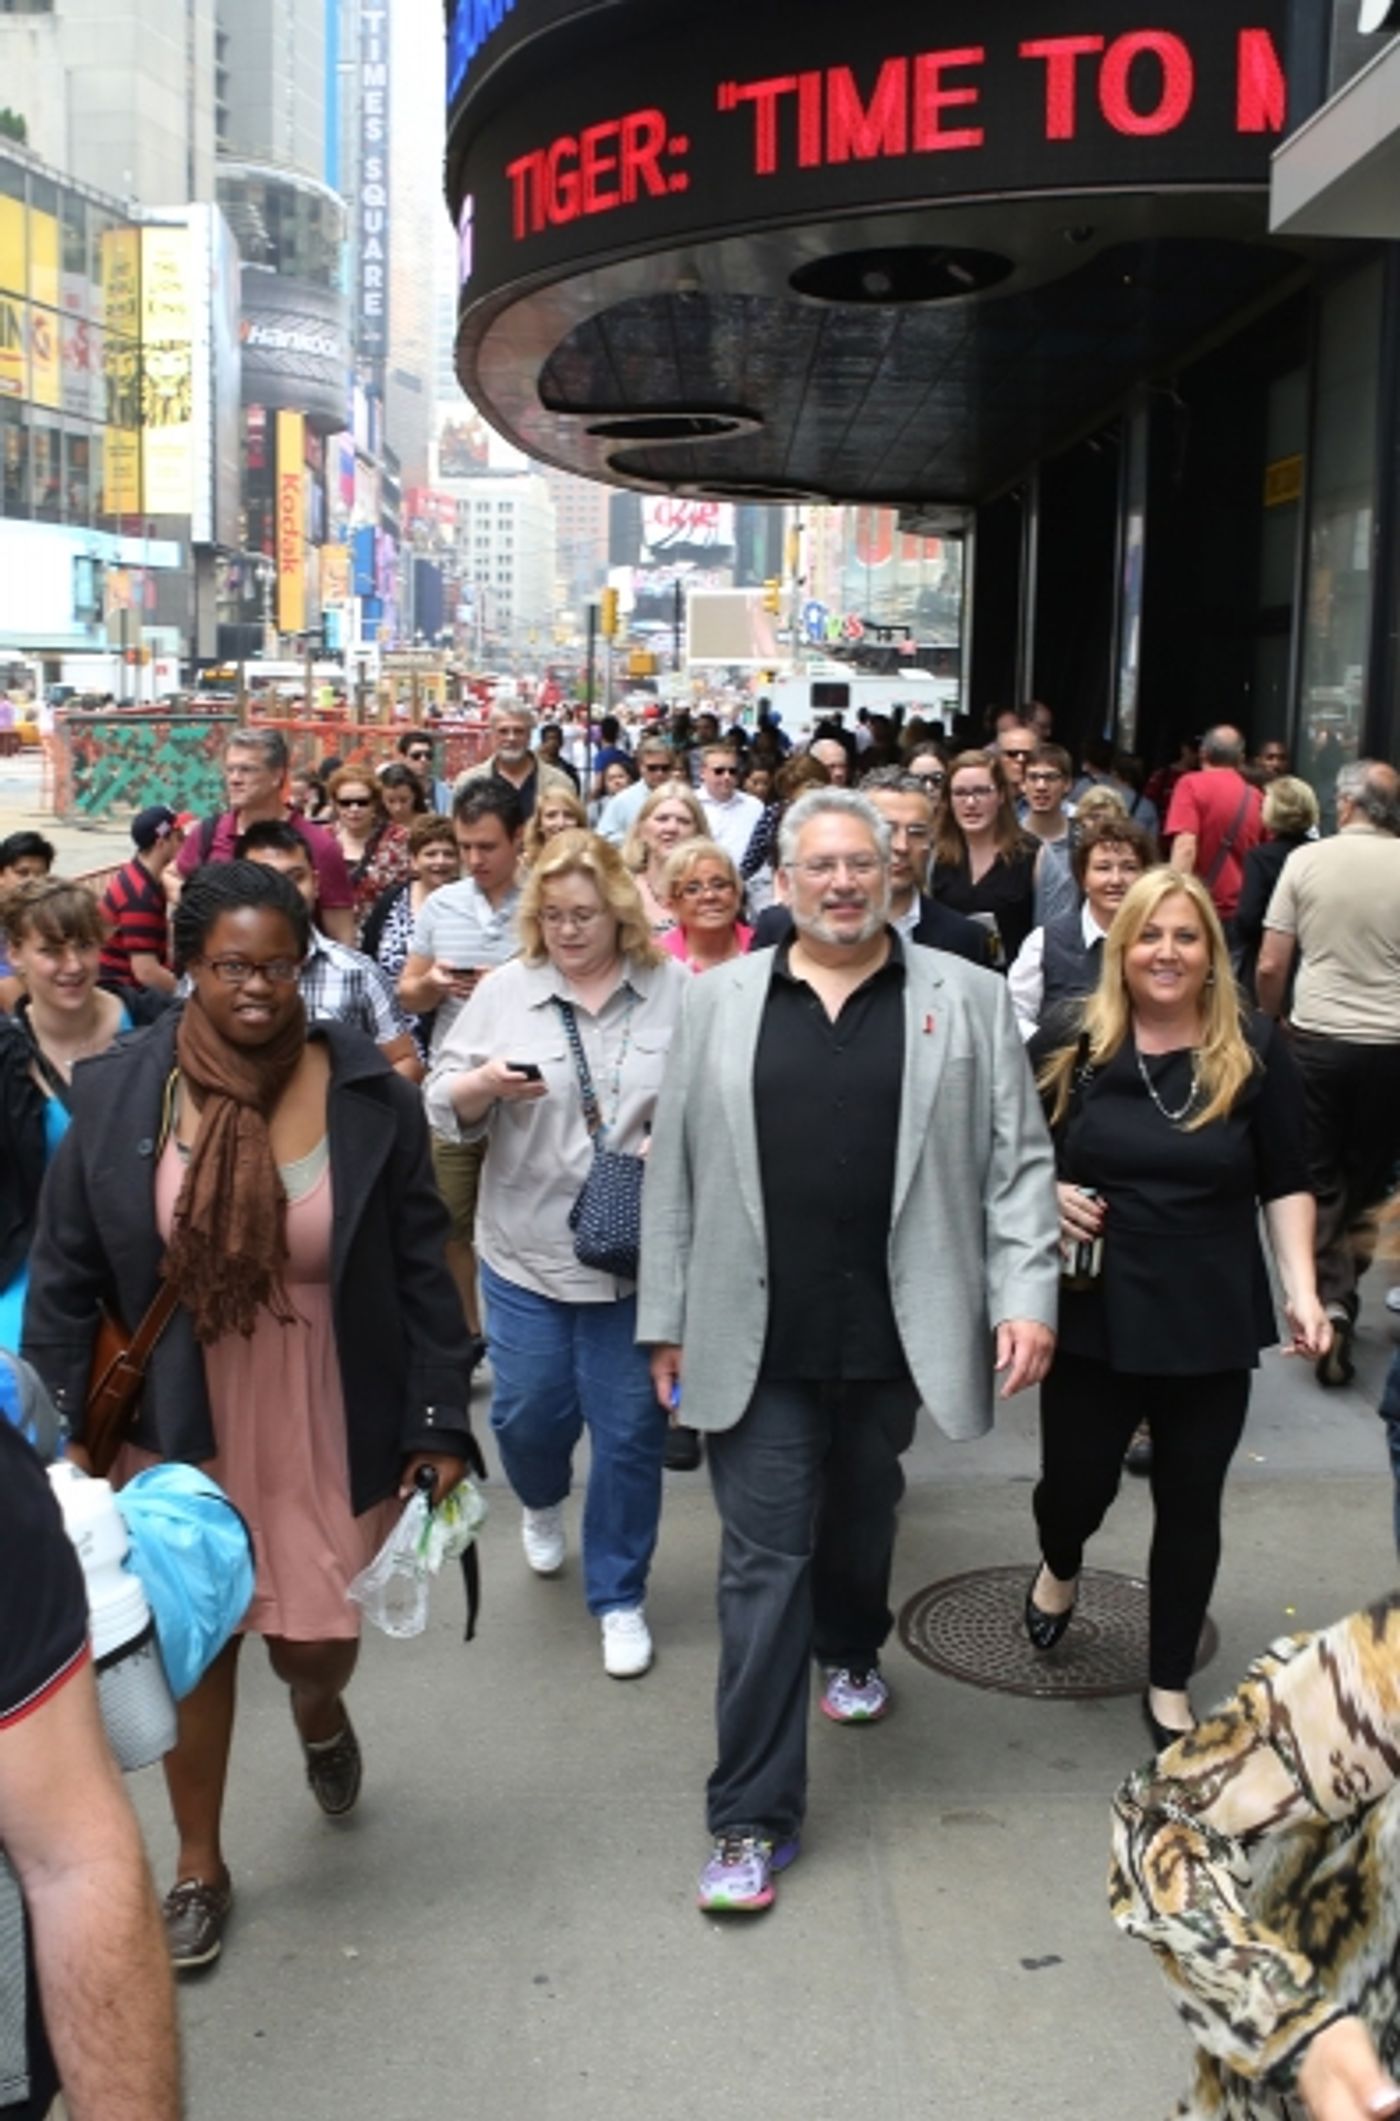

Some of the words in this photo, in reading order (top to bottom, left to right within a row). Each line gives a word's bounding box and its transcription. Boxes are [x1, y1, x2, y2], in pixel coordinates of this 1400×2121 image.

[362, 10, 387, 141] TIMES
[506, 108, 688, 239] TIGER:
[717, 47, 984, 175] "TIME
[1019, 29, 1194, 139] TO
[362, 157, 387, 316] SQUARE
[283, 473, 300, 574] Kodak
